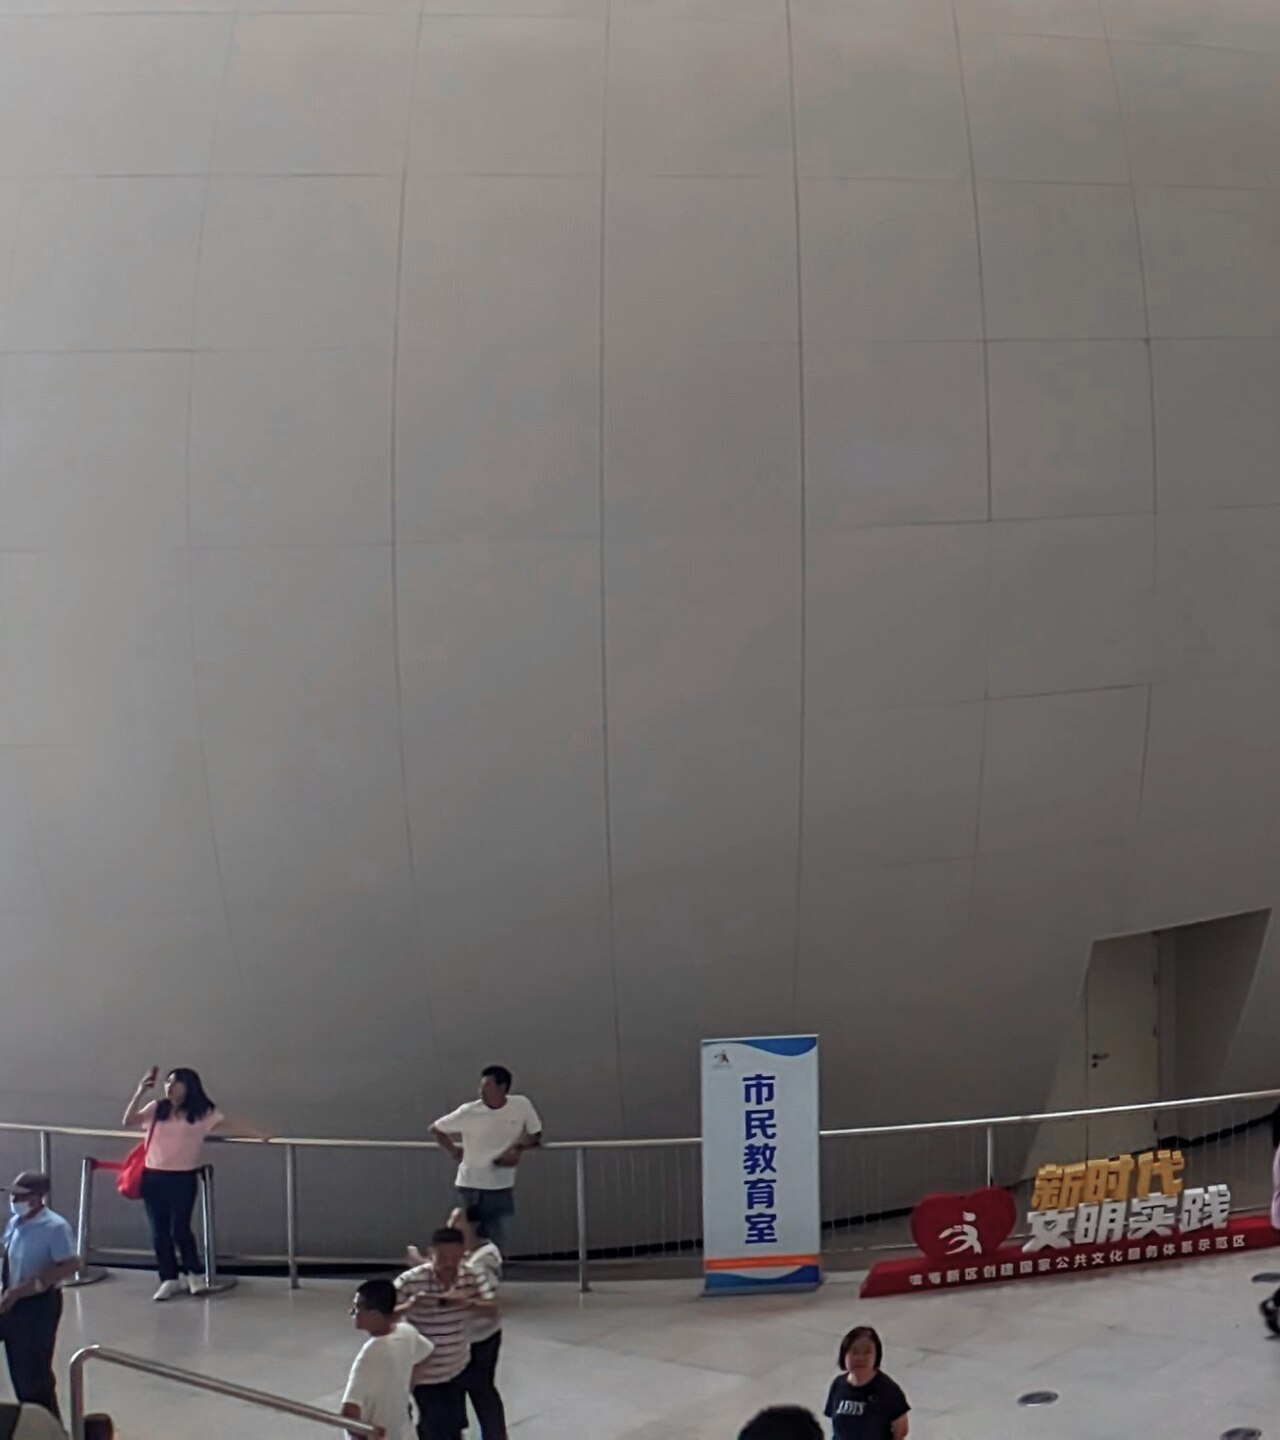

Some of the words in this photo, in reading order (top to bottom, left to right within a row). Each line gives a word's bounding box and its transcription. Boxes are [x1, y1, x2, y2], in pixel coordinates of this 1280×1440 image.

[742, 1073, 778, 1245] 市民教育室
[1031, 1149, 1186, 1210] 新时代
[1021, 1183, 1231, 1254] 文明实践
